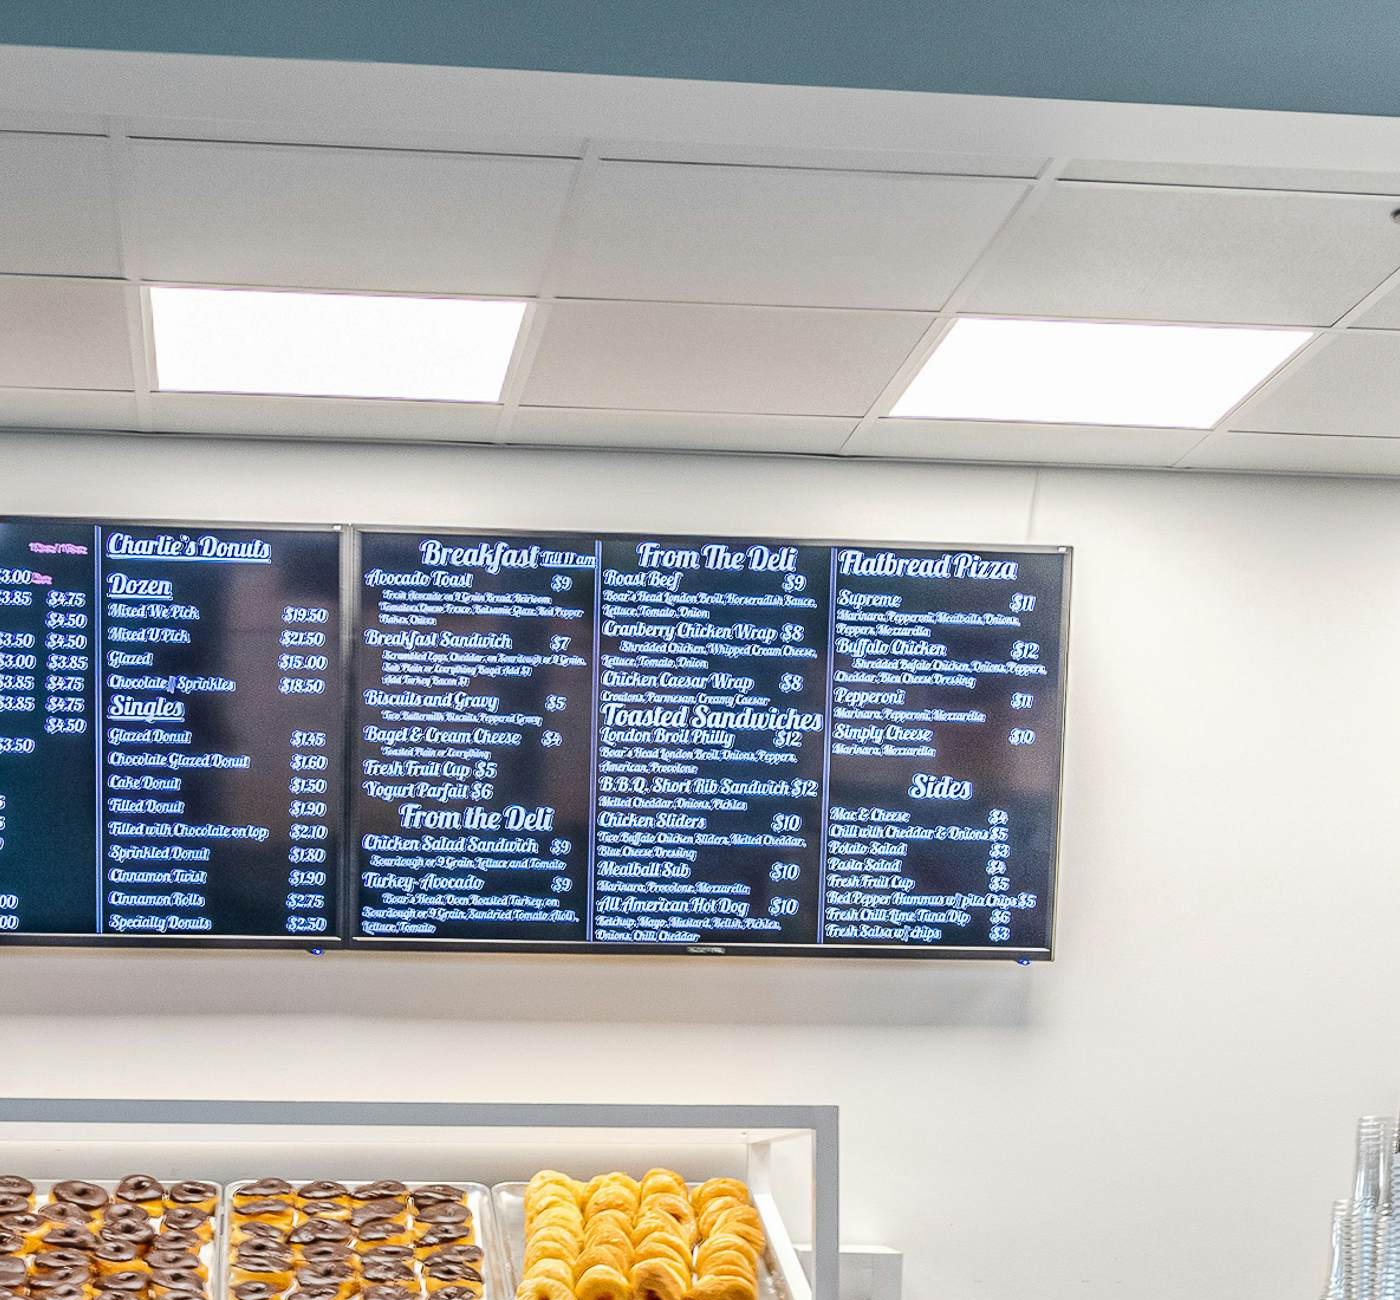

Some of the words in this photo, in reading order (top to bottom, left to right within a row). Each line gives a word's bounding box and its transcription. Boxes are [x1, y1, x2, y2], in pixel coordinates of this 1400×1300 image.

[107, 533, 196, 556] Charlie's
[198, 536, 271, 558] Donuts
[419, 540, 540, 574] Breakfast
[636, 542, 700, 569] From
[700, 544, 745, 571] The
[746, 544, 798, 572] Deli
[838, 549, 951, 578] Flatbread
[953, 553, 1018, 580] Pizza
[108, 572, 172, 594] Dozen
[364, 568, 430, 587] Avocado
[431, 570, 473, 588] Toast
[551, 574, 572, 591] $9
[602, 569, 648, 586] Roast
[648, 570, 683, 592] Beef
[782, 572, 806, 592] $9
[47, 590, 86, 607] $4.75
[837, 589, 902, 609] Supreme
[1009, 592, 1037, 612] $11
[46, 611, 88, 628] $4.50
[108, 604, 147, 618] Mixed
[148, 605, 169, 619] We
[170, 605, 200, 620] Pick
[283, 607, 328, 624] $19.50
[108, 628, 147, 643] Mixed
[161, 629, 191, 644] Pick
[279, 631, 326, 647] $21.50
[364, 629, 439, 650] Breakfast
[439, 631, 512, 650] Sandwich
[550, 635, 571, 651] $7
[602, 621, 677, 641] Cranberry
[676, 622, 733, 640] Chicken
[732, 623, 778, 644] Wrap
[780, 623, 804, 643] $8
[835, 638, 891, 657] Buffalo
[890, 639, 947, 656] Chicken
[1010, 640, 1040, 660] $12
[46, 654, 88, 671] $3.85
[108, 651, 153, 668] Glazed
[278, 654, 328, 671] $15.00
[602, 670, 659, 688] Chicken
[658, 672, 709, 689] Caesar
[708, 673, 754, 694] Wrap
[779, 672, 803, 693] $8
[108, 695, 185, 722] Singles
[363, 689, 424, 706] Biscuits
[424, 692, 451, 707] and
[451, 691, 500, 712] Gravy
[544, 694, 567, 711] $5
[833, 687, 906, 707] Pepperoni
[1010, 693, 1034, 710] $11
[600, 702, 689, 729] Toasted
[692, 704, 824, 732] Sandwiches
[108, 729, 150, 745] Glazed
[150, 730, 192, 744] Donut
[290, 731, 326, 748] $1.45
[363, 725, 410, 745] Bagel
[410, 727, 426, 742] &
[425, 727, 473, 743] Cream
[473, 728, 522, 745] Cheese
[541, 730, 562, 747] $4
[599, 727, 653, 746] London
[653, 728, 690, 745] Broil
[690, 728, 736, 748] Philly
[773, 729, 802, 748] $12
[832, 723, 886, 744] Simply
[885, 724, 934, 741] Cheese
[1008, 728, 1036, 745] $10
[108, 752, 167, 766] Chocolate
[168, 753, 211, 769] Glazed
[211, 754, 250, 769] Donut
[290, 754, 328, 771] $1.60
[363, 760, 405, 776] Fresh
[405, 760, 442, 777] Fruit
[442, 761, 472, 780] Cup
[473, 760, 497, 778] $5
[108, 774, 143, 789] Cake
[143, 776, 181, 791] Donut
[290, 778, 328, 794] $1.50
[363, 780, 416, 800] Yogurt
[416, 782, 470, 802] Parfait
[470, 782, 493, 800] $6
[599, 776, 650, 794] B.B.Q.
[652, 777, 694, 794] Short
[693, 778, 721, 794] Rib
[720, 779, 791, 796] Sandwich
[791, 778, 819, 797] $12
[908, 773, 973, 800] Sides
[398, 803, 461, 829] From
[463, 806, 503, 830] the
[503, 805, 555, 831] Deli
[597, 812, 655, 828] Chicken
[655, 812, 707, 829] Sliders
[771, 813, 802, 832] $10
[830, 807, 858, 821] Mac
[857, 807, 870, 821] &
[870, 808, 911, 822] Cheese
[108, 845, 171, 862] Sprinkled
[171, 847, 210, 861] Donut
[289, 848, 326, 864] $1.80
[362, 834, 421, 851] Chicken
[421, 835, 468, 851] Salad
[467, 837, 539, 853] Sandwich
[550, 838, 571, 855] $9
[597, 861, 662, 877] Meatball
[662, 862, 691, 879] Sub
[769, 862, 800, 881] $10
